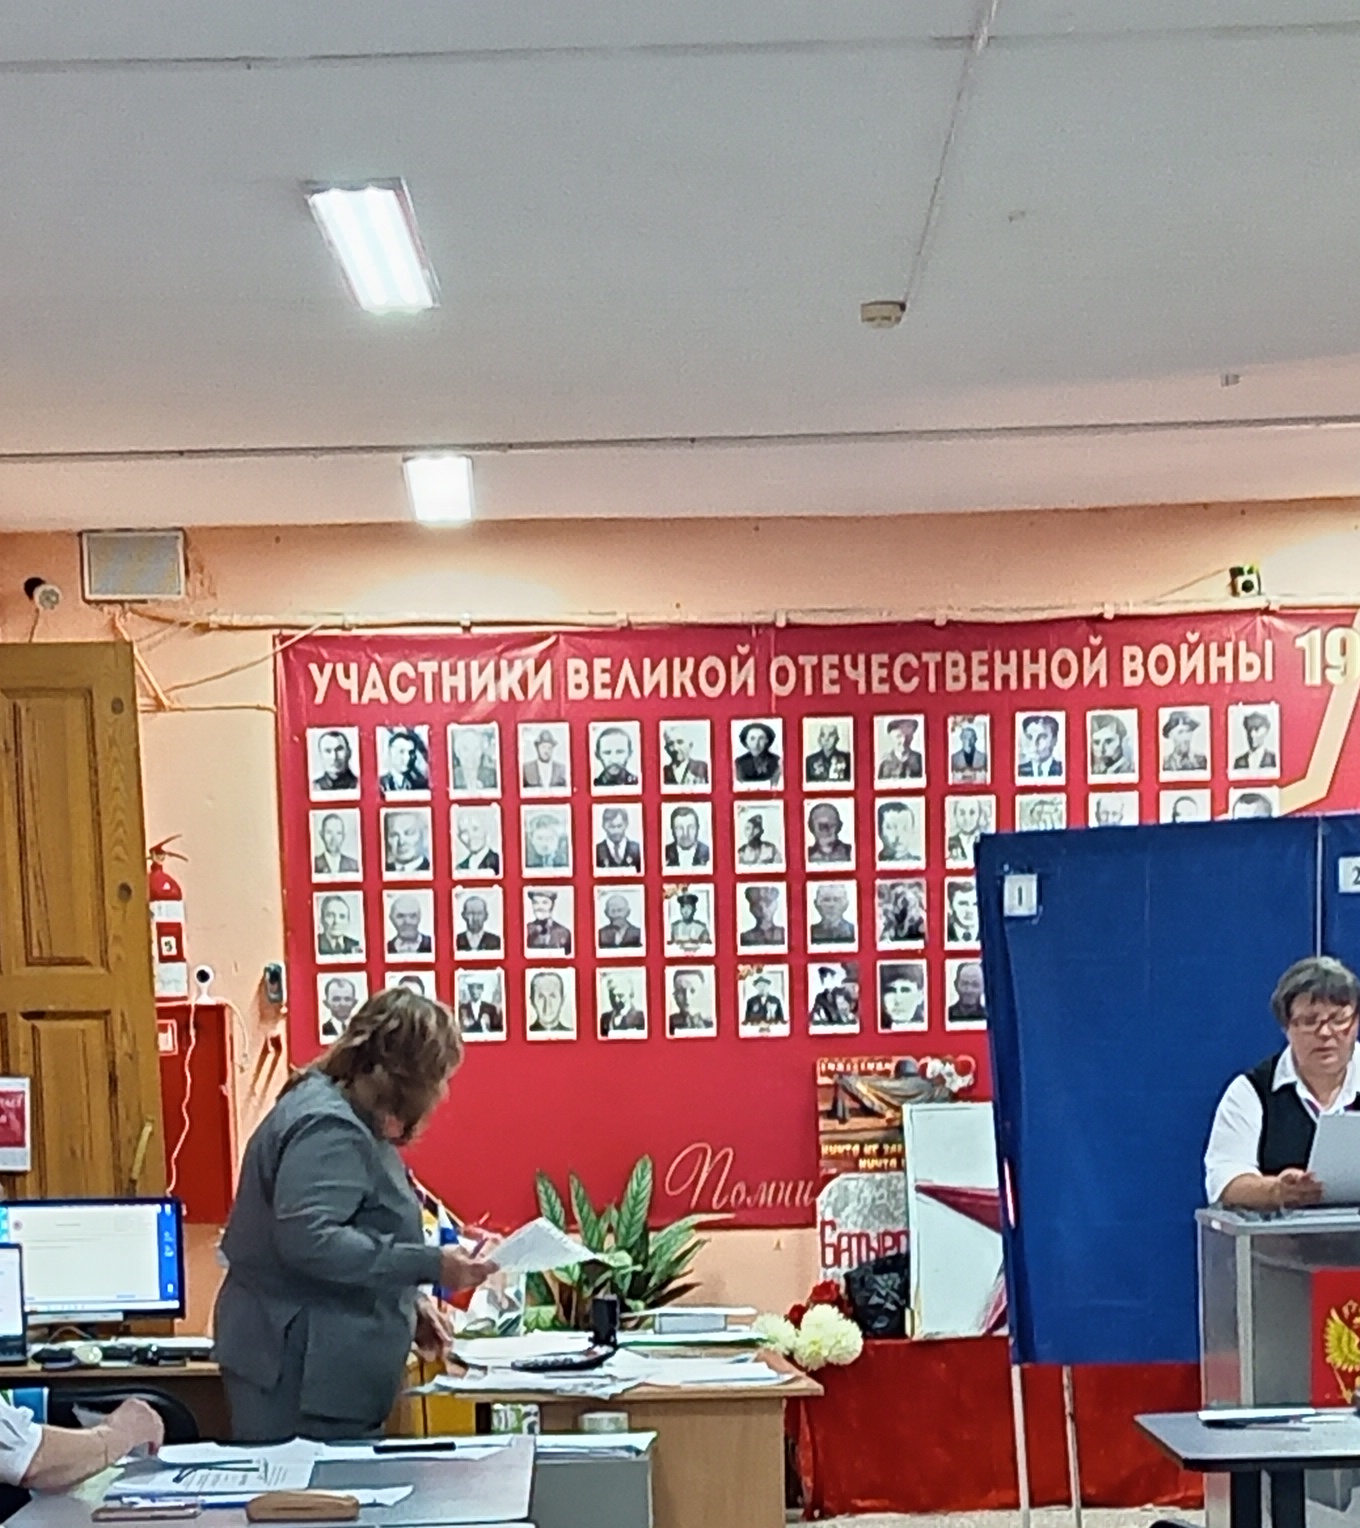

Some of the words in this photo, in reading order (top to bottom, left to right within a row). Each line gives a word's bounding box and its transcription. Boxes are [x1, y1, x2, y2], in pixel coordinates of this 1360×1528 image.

[307, 656, 553, 705] УЧАСТНИКИ
[566, 643, 757, 699] ВЕЛИКОЙ
[768, 635, 1108, 696] ОТЕЧЕСТВЕННОЙ
[1121, 631, 1274, 688] ВОЙНЫ
[665, 1143, 817, 1210] Помни
